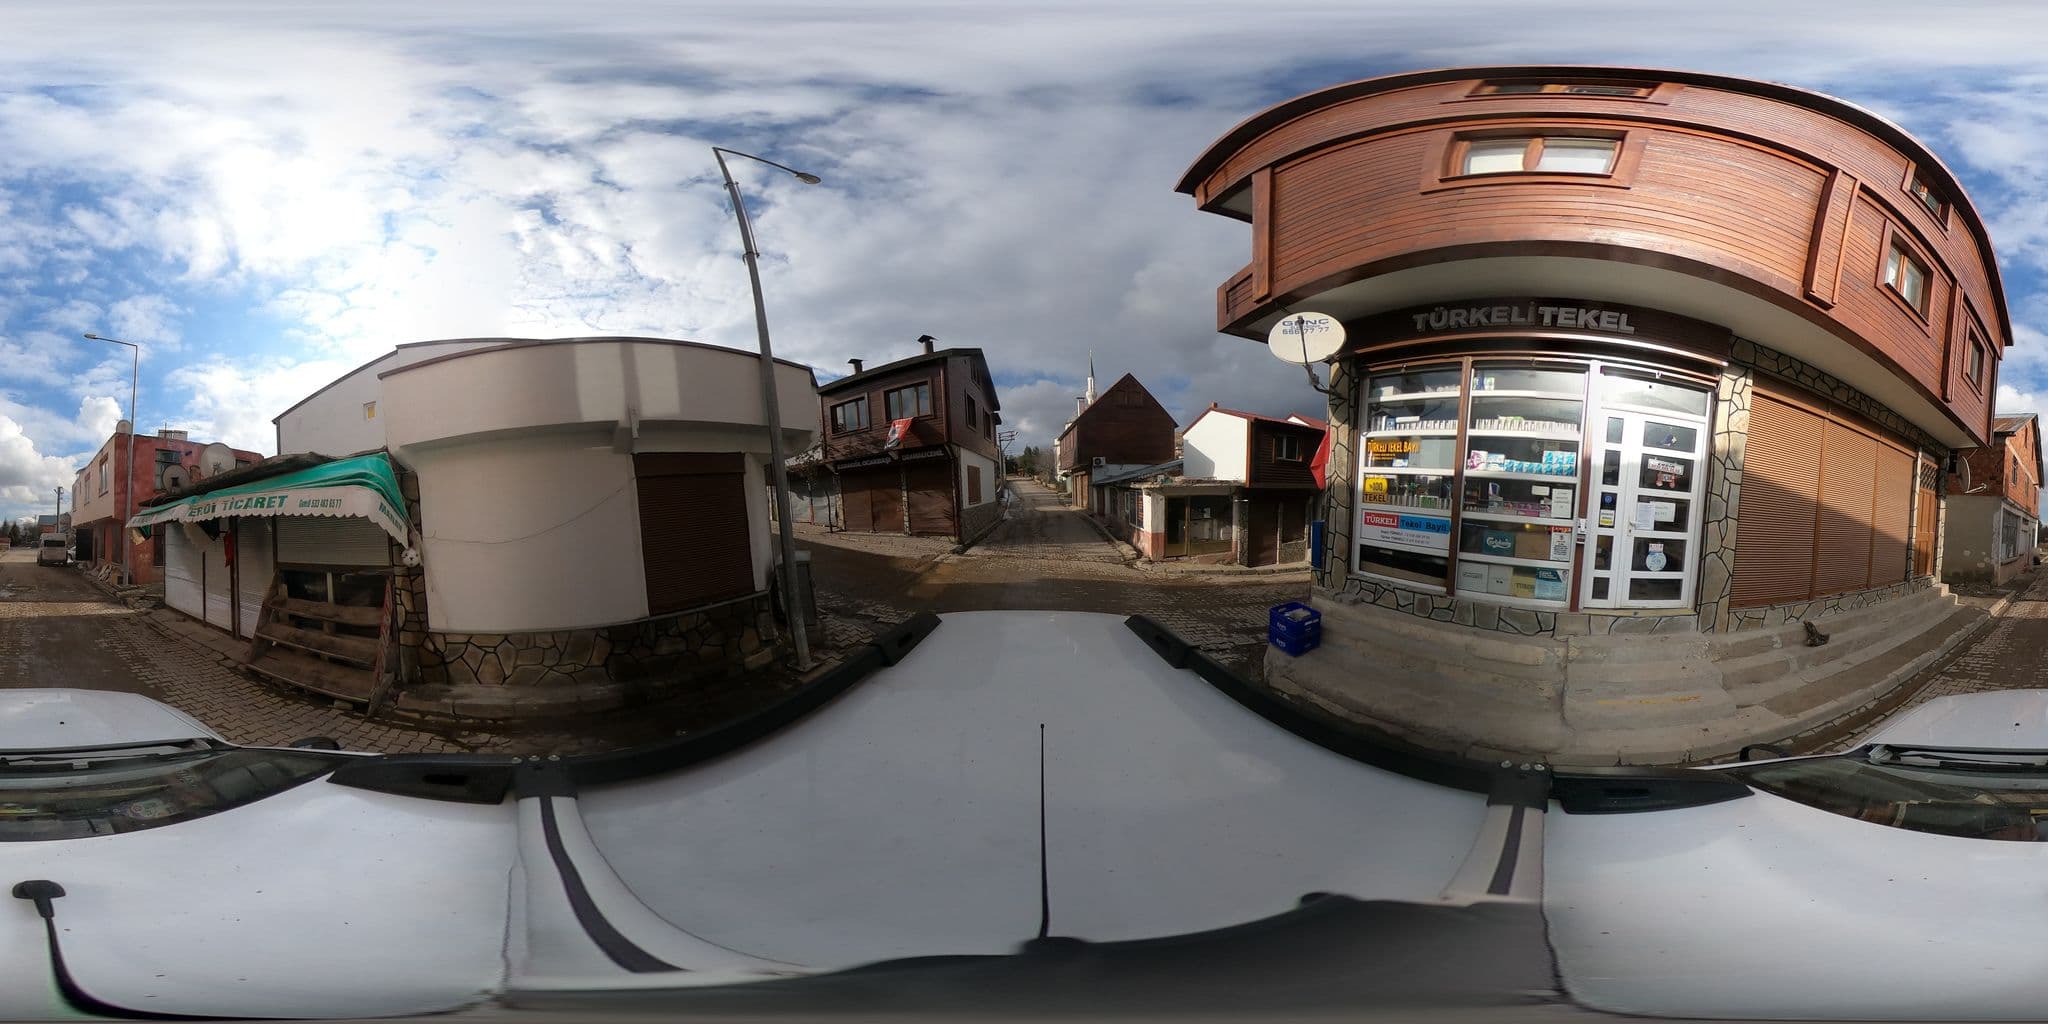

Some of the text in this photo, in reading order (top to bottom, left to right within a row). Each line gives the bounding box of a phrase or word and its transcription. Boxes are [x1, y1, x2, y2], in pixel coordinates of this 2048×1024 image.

[1412, 301, 1635, 334] TÜRKELİ TEKEL
[223, 495, 288, 511] TİCARET
[1364, 493, 1386, 503] TEKEL
[1366, 514, 1397, 526] TÜRKELİ
[1400, 519, 1422, 529] Tekel
